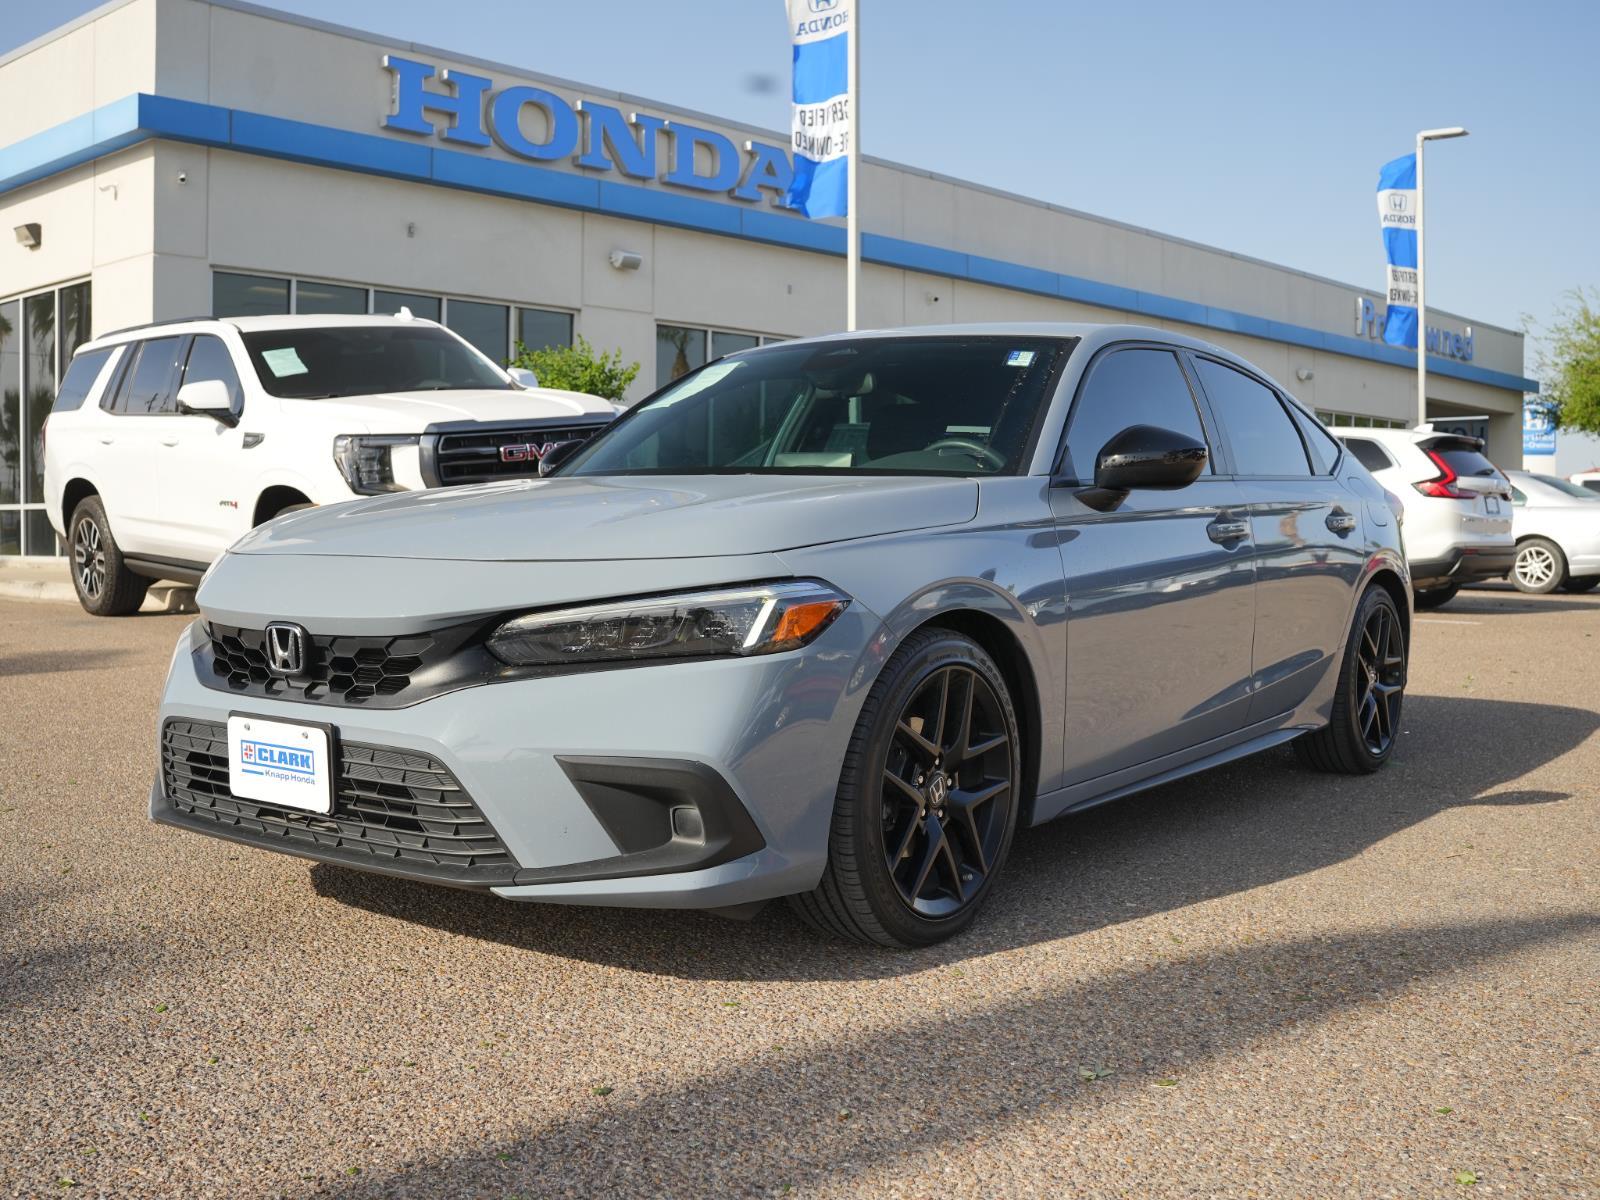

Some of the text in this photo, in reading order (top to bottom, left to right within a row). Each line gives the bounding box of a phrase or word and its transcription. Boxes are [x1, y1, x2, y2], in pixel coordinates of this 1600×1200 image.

[380, 54, 794, 207] HONDA
[500, 441, 567, 462] GM
[258, 748, 311, 769] CLARK
[265, 769, 316, 785] Knapp Honda
